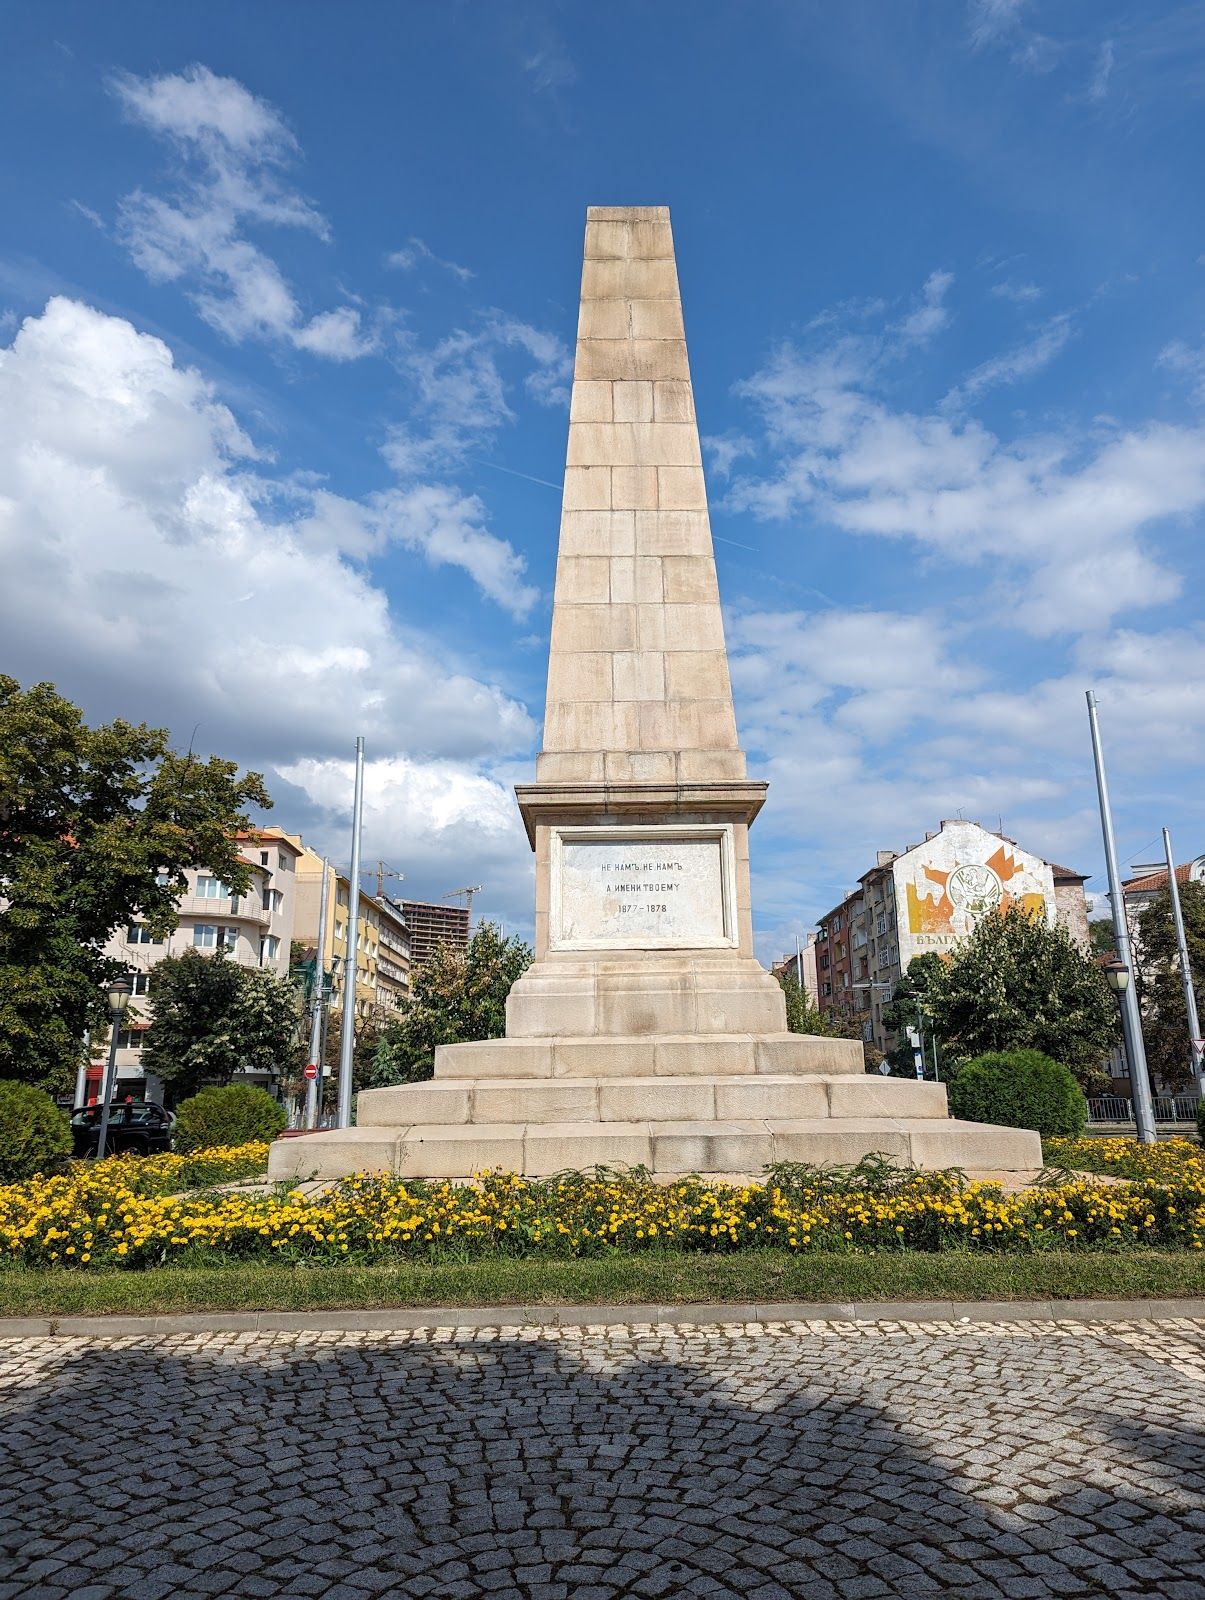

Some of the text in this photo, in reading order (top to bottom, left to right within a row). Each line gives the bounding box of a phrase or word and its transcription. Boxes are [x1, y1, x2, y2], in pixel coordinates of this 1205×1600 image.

[601, 863, 611, 872] НЕ
[643, 862, 653, 871] НЕ
[606, 884, 611, 892] А
[614, 883, 641, 892] ИМЕНИ
[917, 935, 971, 945] БЪЛГАР
